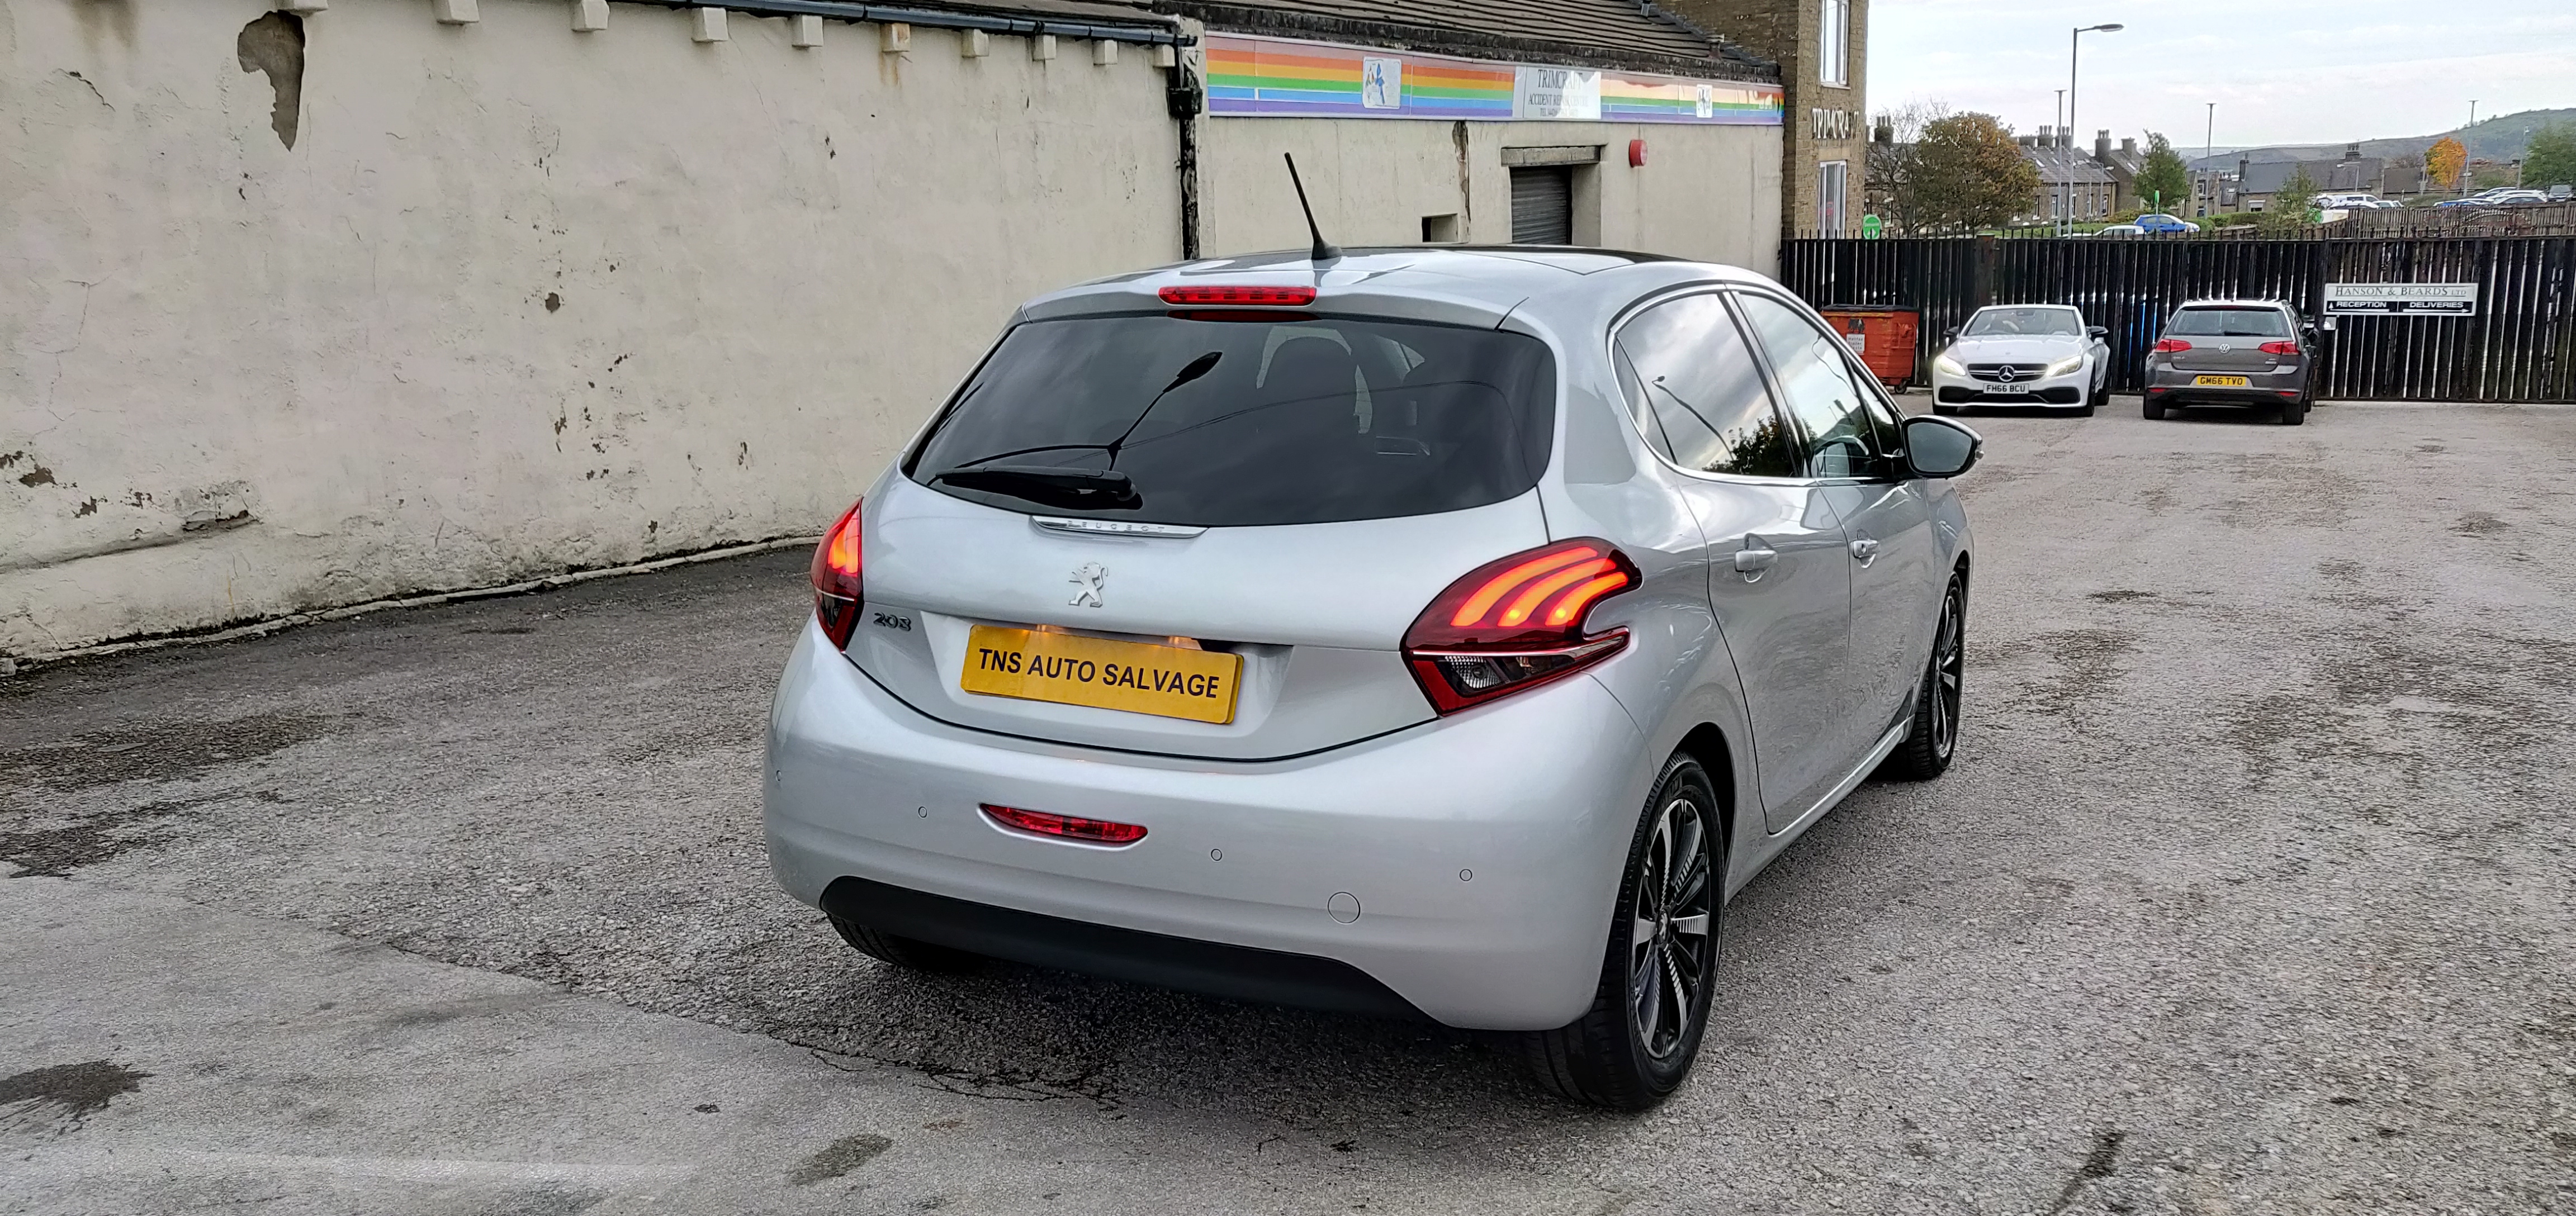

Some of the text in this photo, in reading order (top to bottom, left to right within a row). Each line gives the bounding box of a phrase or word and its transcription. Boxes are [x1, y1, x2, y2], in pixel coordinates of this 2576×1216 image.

[1528, 93, 1552, 106] ACCIDENT
[2336, 286, 2384, 296] HANSON
[2388, 288, 2396, 296] &
[2401, 287, 2448, 296] BEARDS
[2200, 377, 2243, 386] GM66 TVO
[1066, 520, 1165, 533] PEUGEOT
[873, 612, 911, 631] 208
[979, 648, 1220, 698] TNS AUTO SALVAGE
